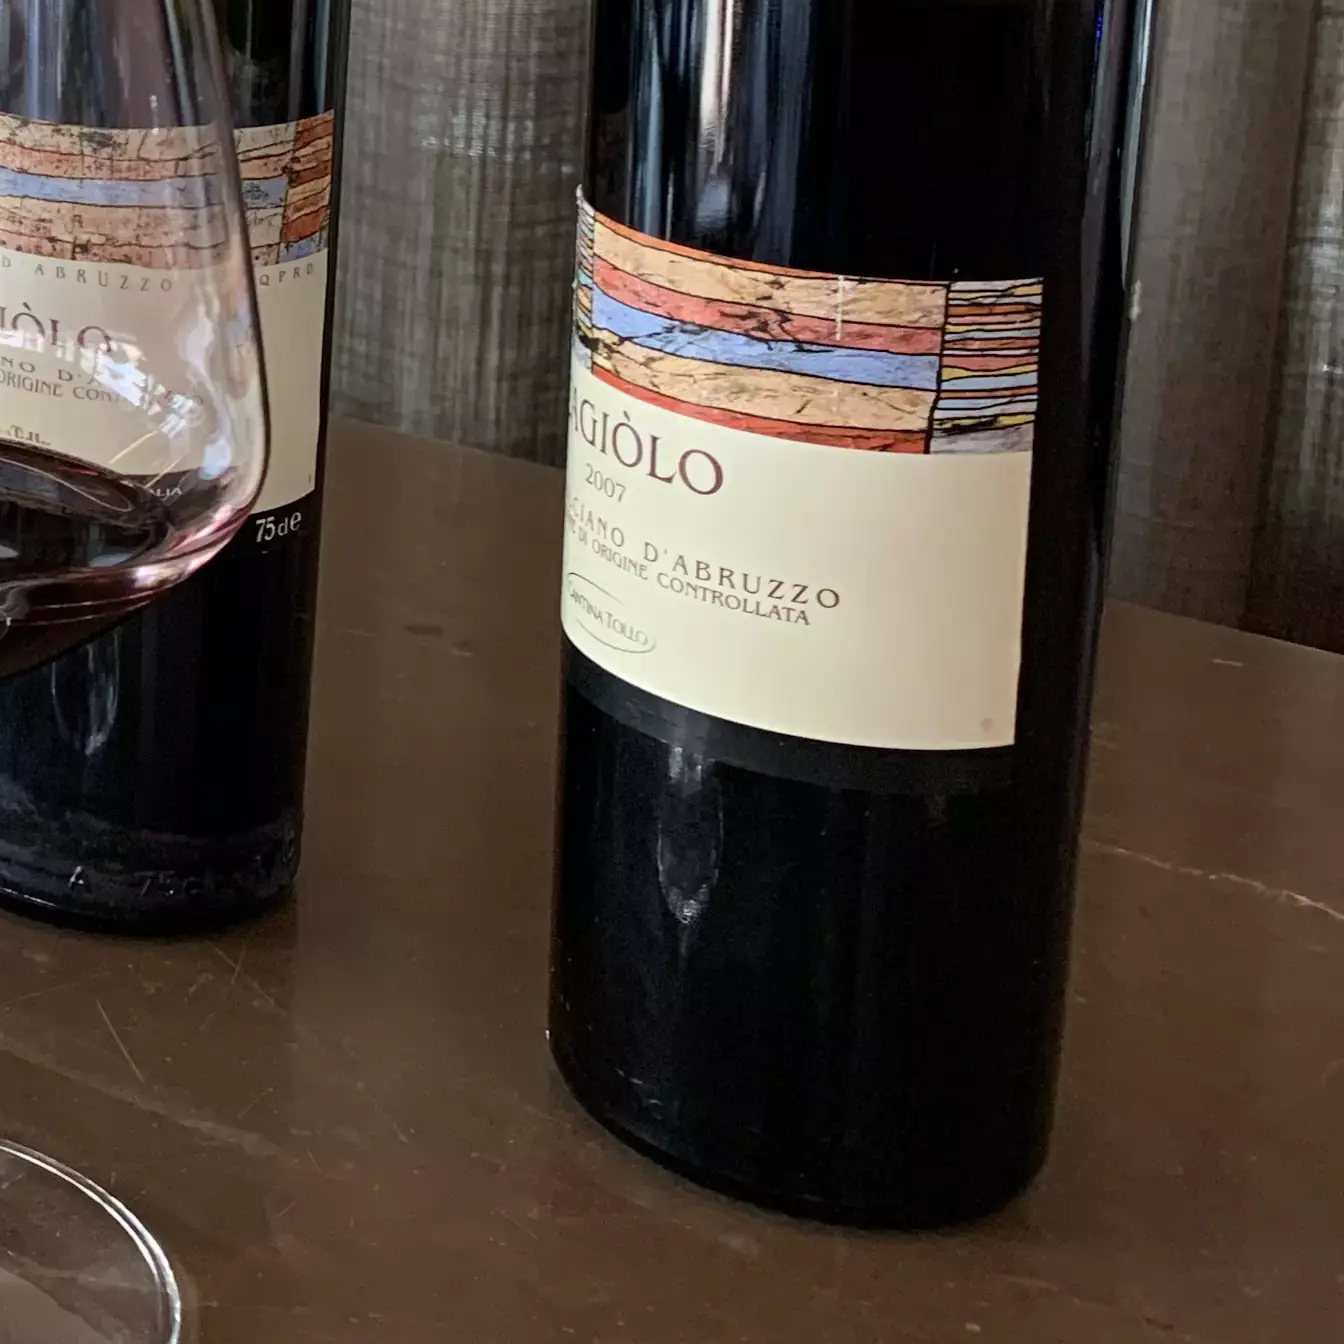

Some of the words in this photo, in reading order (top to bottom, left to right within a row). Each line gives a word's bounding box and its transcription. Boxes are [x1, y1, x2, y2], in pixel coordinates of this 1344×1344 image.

[585, 462, 627, 504] 2007
[591, 538, 649, 581] ORIGINE
[656, 571, 811, 626] CONTROLLATA
[642, 541, 841, 610] D'ABRUZZO
